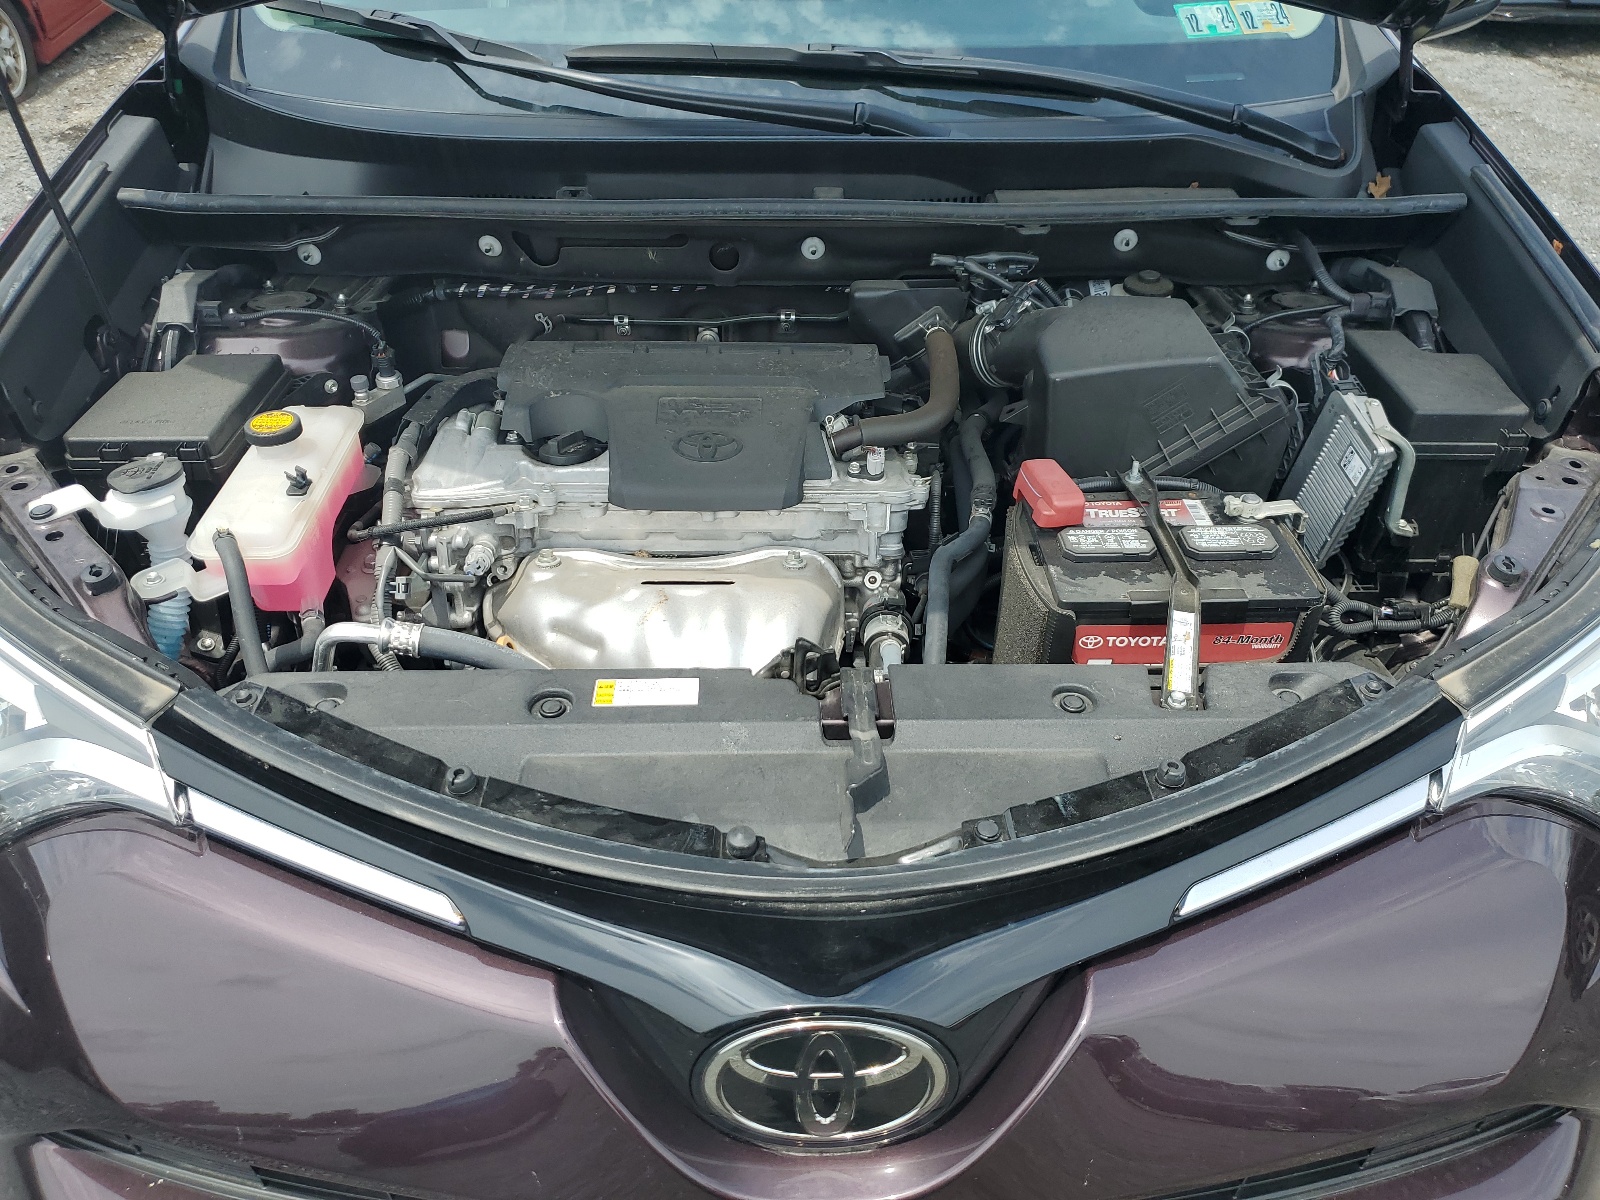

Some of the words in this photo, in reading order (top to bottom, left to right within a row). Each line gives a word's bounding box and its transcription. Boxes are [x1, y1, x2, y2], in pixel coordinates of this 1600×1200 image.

[1185, 13, 1203, 33] 12
[1216, 6, 1236, 29] 24
[1240, 10, 1259, 30] 12
[1270, 2, 1291, 25] 24
[1106, 636, 1167, 647] TOYOTA
[1212, 633, 1285, 645] 84-Month
